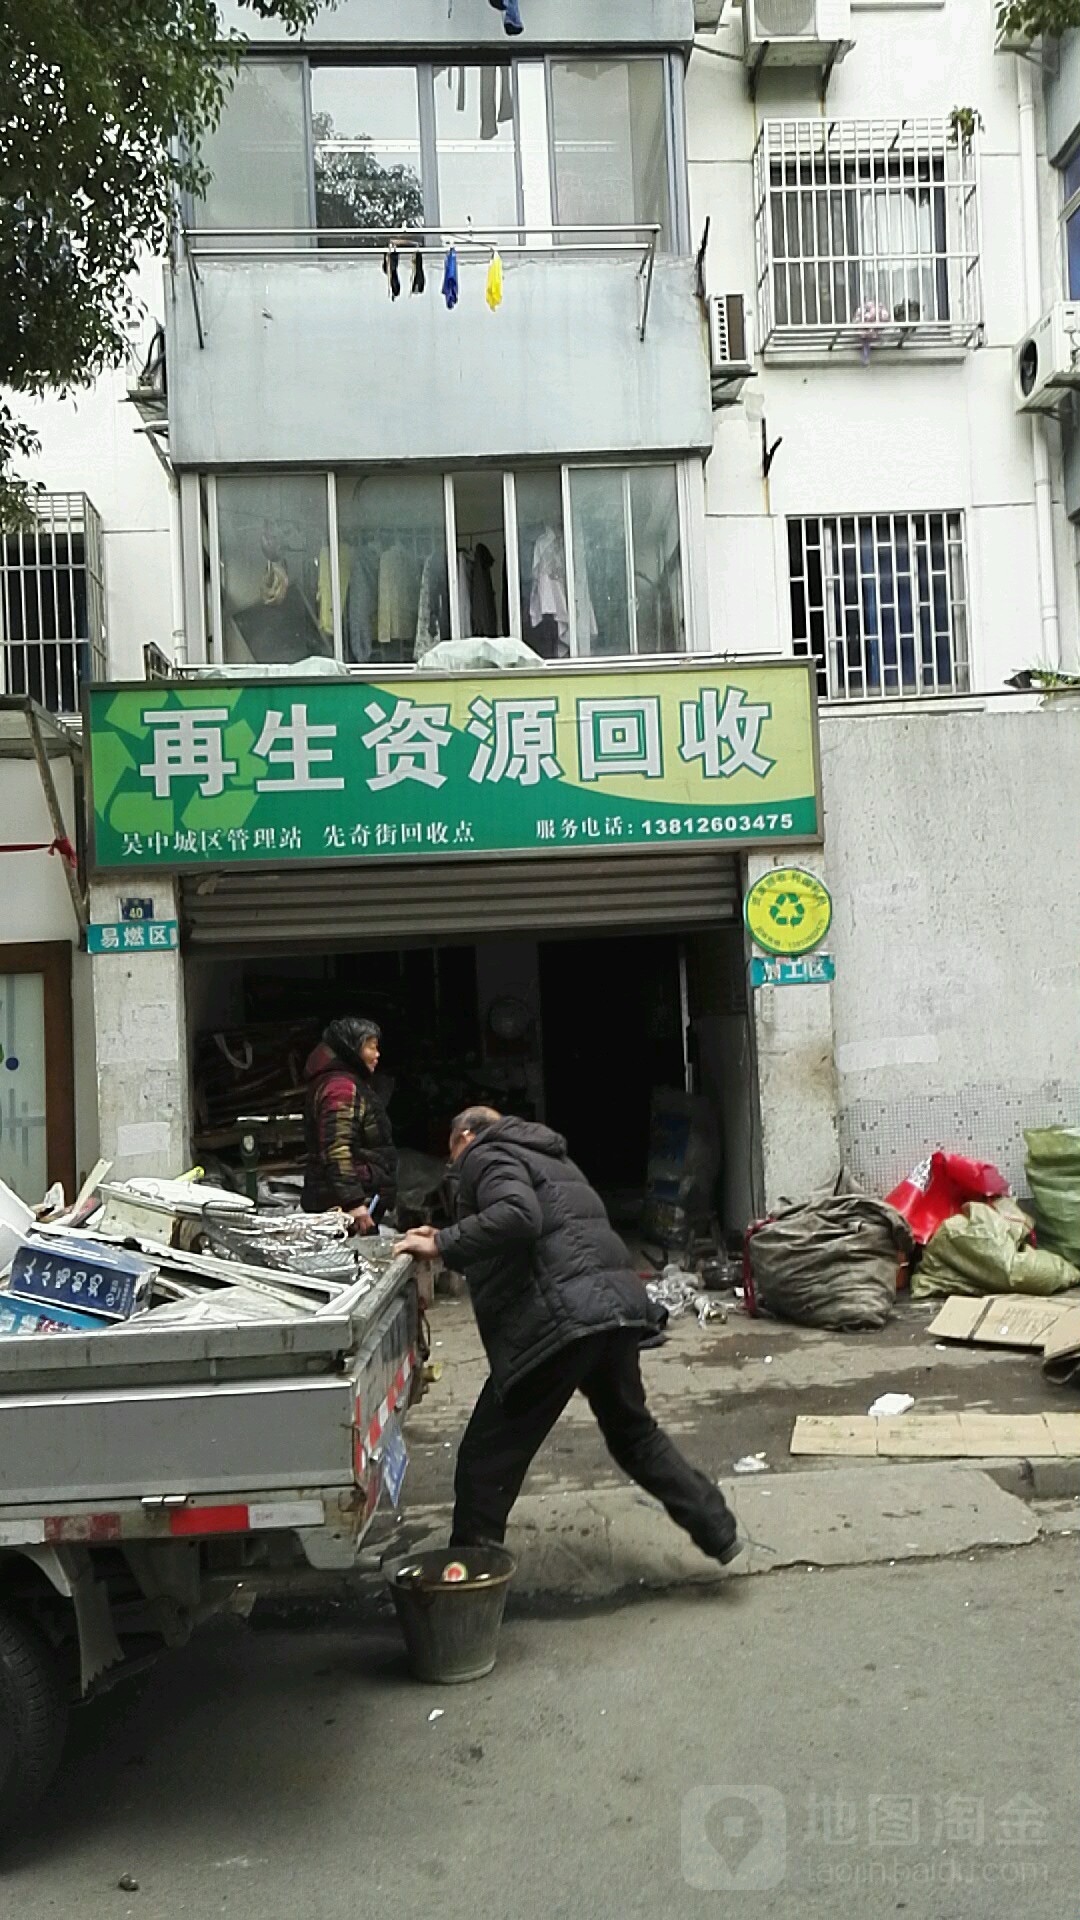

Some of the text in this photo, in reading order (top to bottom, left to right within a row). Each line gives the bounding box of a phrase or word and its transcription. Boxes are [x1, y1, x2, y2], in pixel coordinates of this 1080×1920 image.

[139, 687, 777, 797] 再生资源回收
[121, 820, 475, 857] 吴中城区管理站 先奇街回收点
[129, 907, 143, 919] 40
[101, 926, 168, 948] 易燃区
